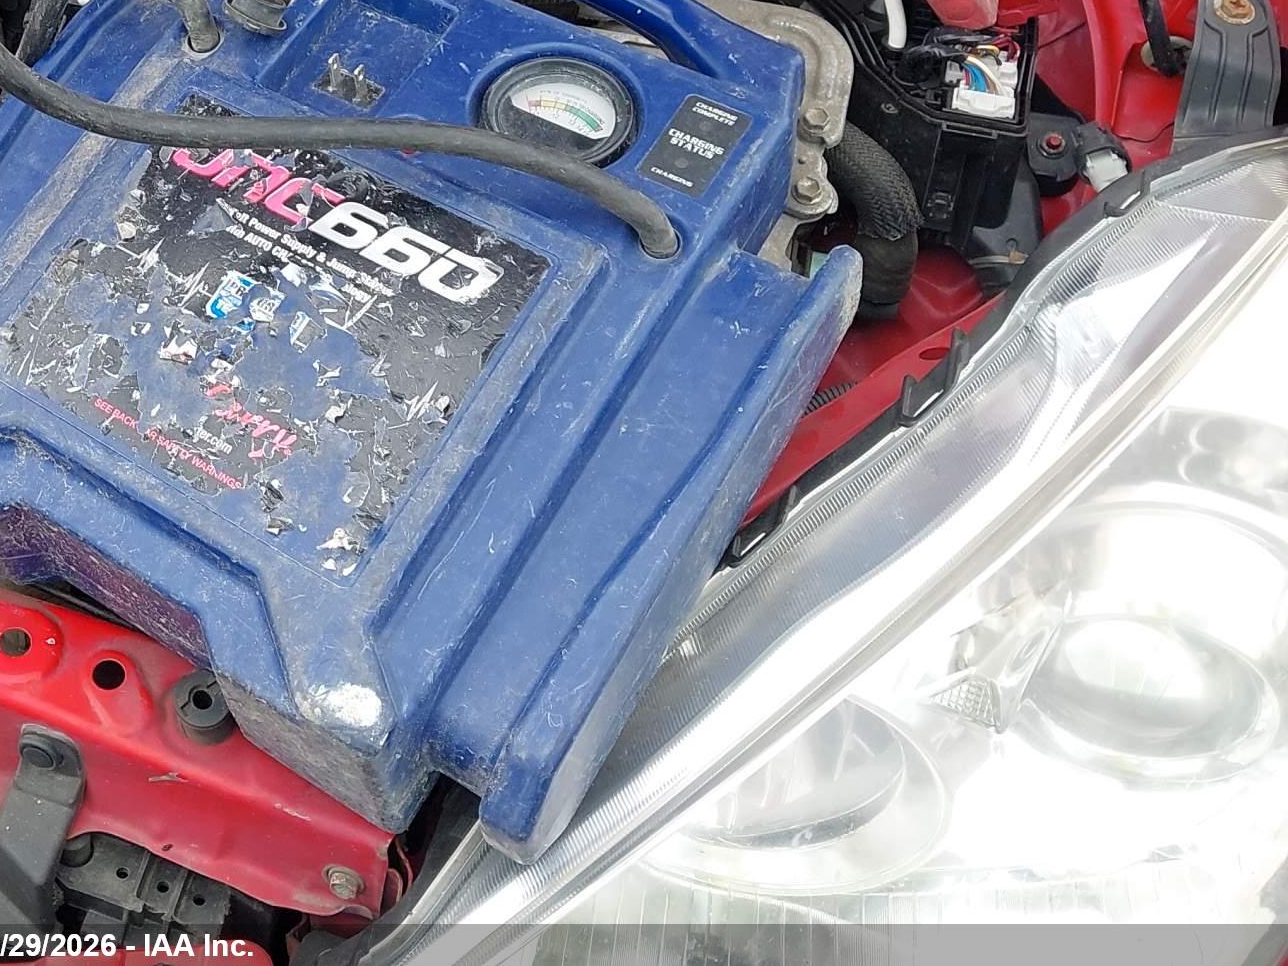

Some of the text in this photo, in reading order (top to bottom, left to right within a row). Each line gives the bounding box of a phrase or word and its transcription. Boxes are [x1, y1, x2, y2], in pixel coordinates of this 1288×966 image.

[692, 106, 735, 126] COMPLETE
[695, 101, 738, 121] CHARGING
[668, 128, 725, 155] CHARGING
[670, 137, 715, 160] STATUS
[650, 166, 693, 188] CHARGING
[244, 231, 272, 252] AUTO
[248, 218, 282, 238] Power
[280, 233, 317, 259] Supply
[315, 251, 327, 263] &
[326, 257, 357, 280] Jump
[93, 398, 138, 429] SEE BACK
[190, 456, 243, 490] WARNINGS
